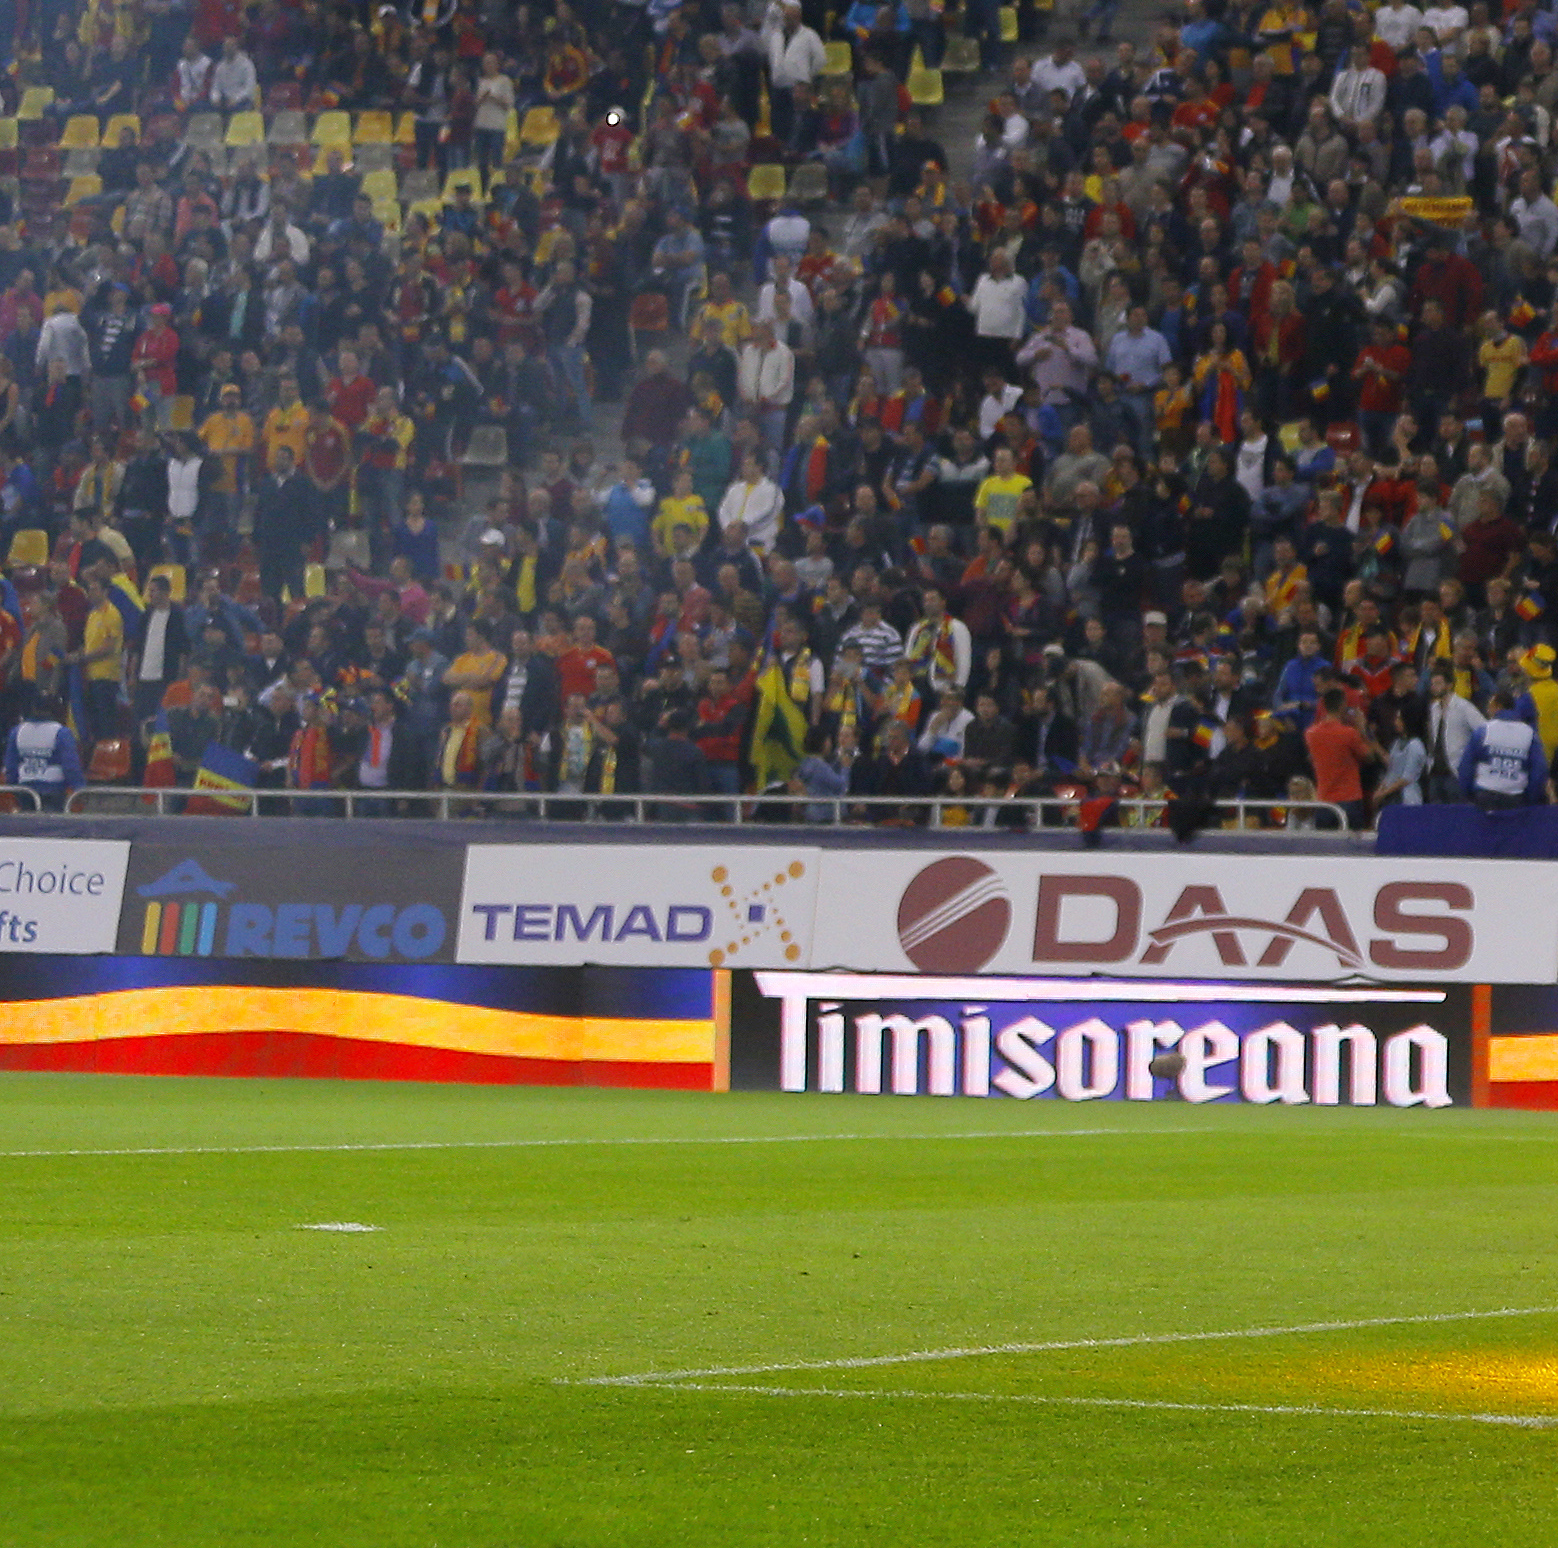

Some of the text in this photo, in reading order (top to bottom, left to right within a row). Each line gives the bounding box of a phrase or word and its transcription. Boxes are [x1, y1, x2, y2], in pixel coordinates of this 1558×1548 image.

[0, 861, 105, 896] Choice
[228, 902, 447, 959] REVCO
[472, 904, 713, 944] TEMAD
[1031, 873, 1475, 972] DAAS
